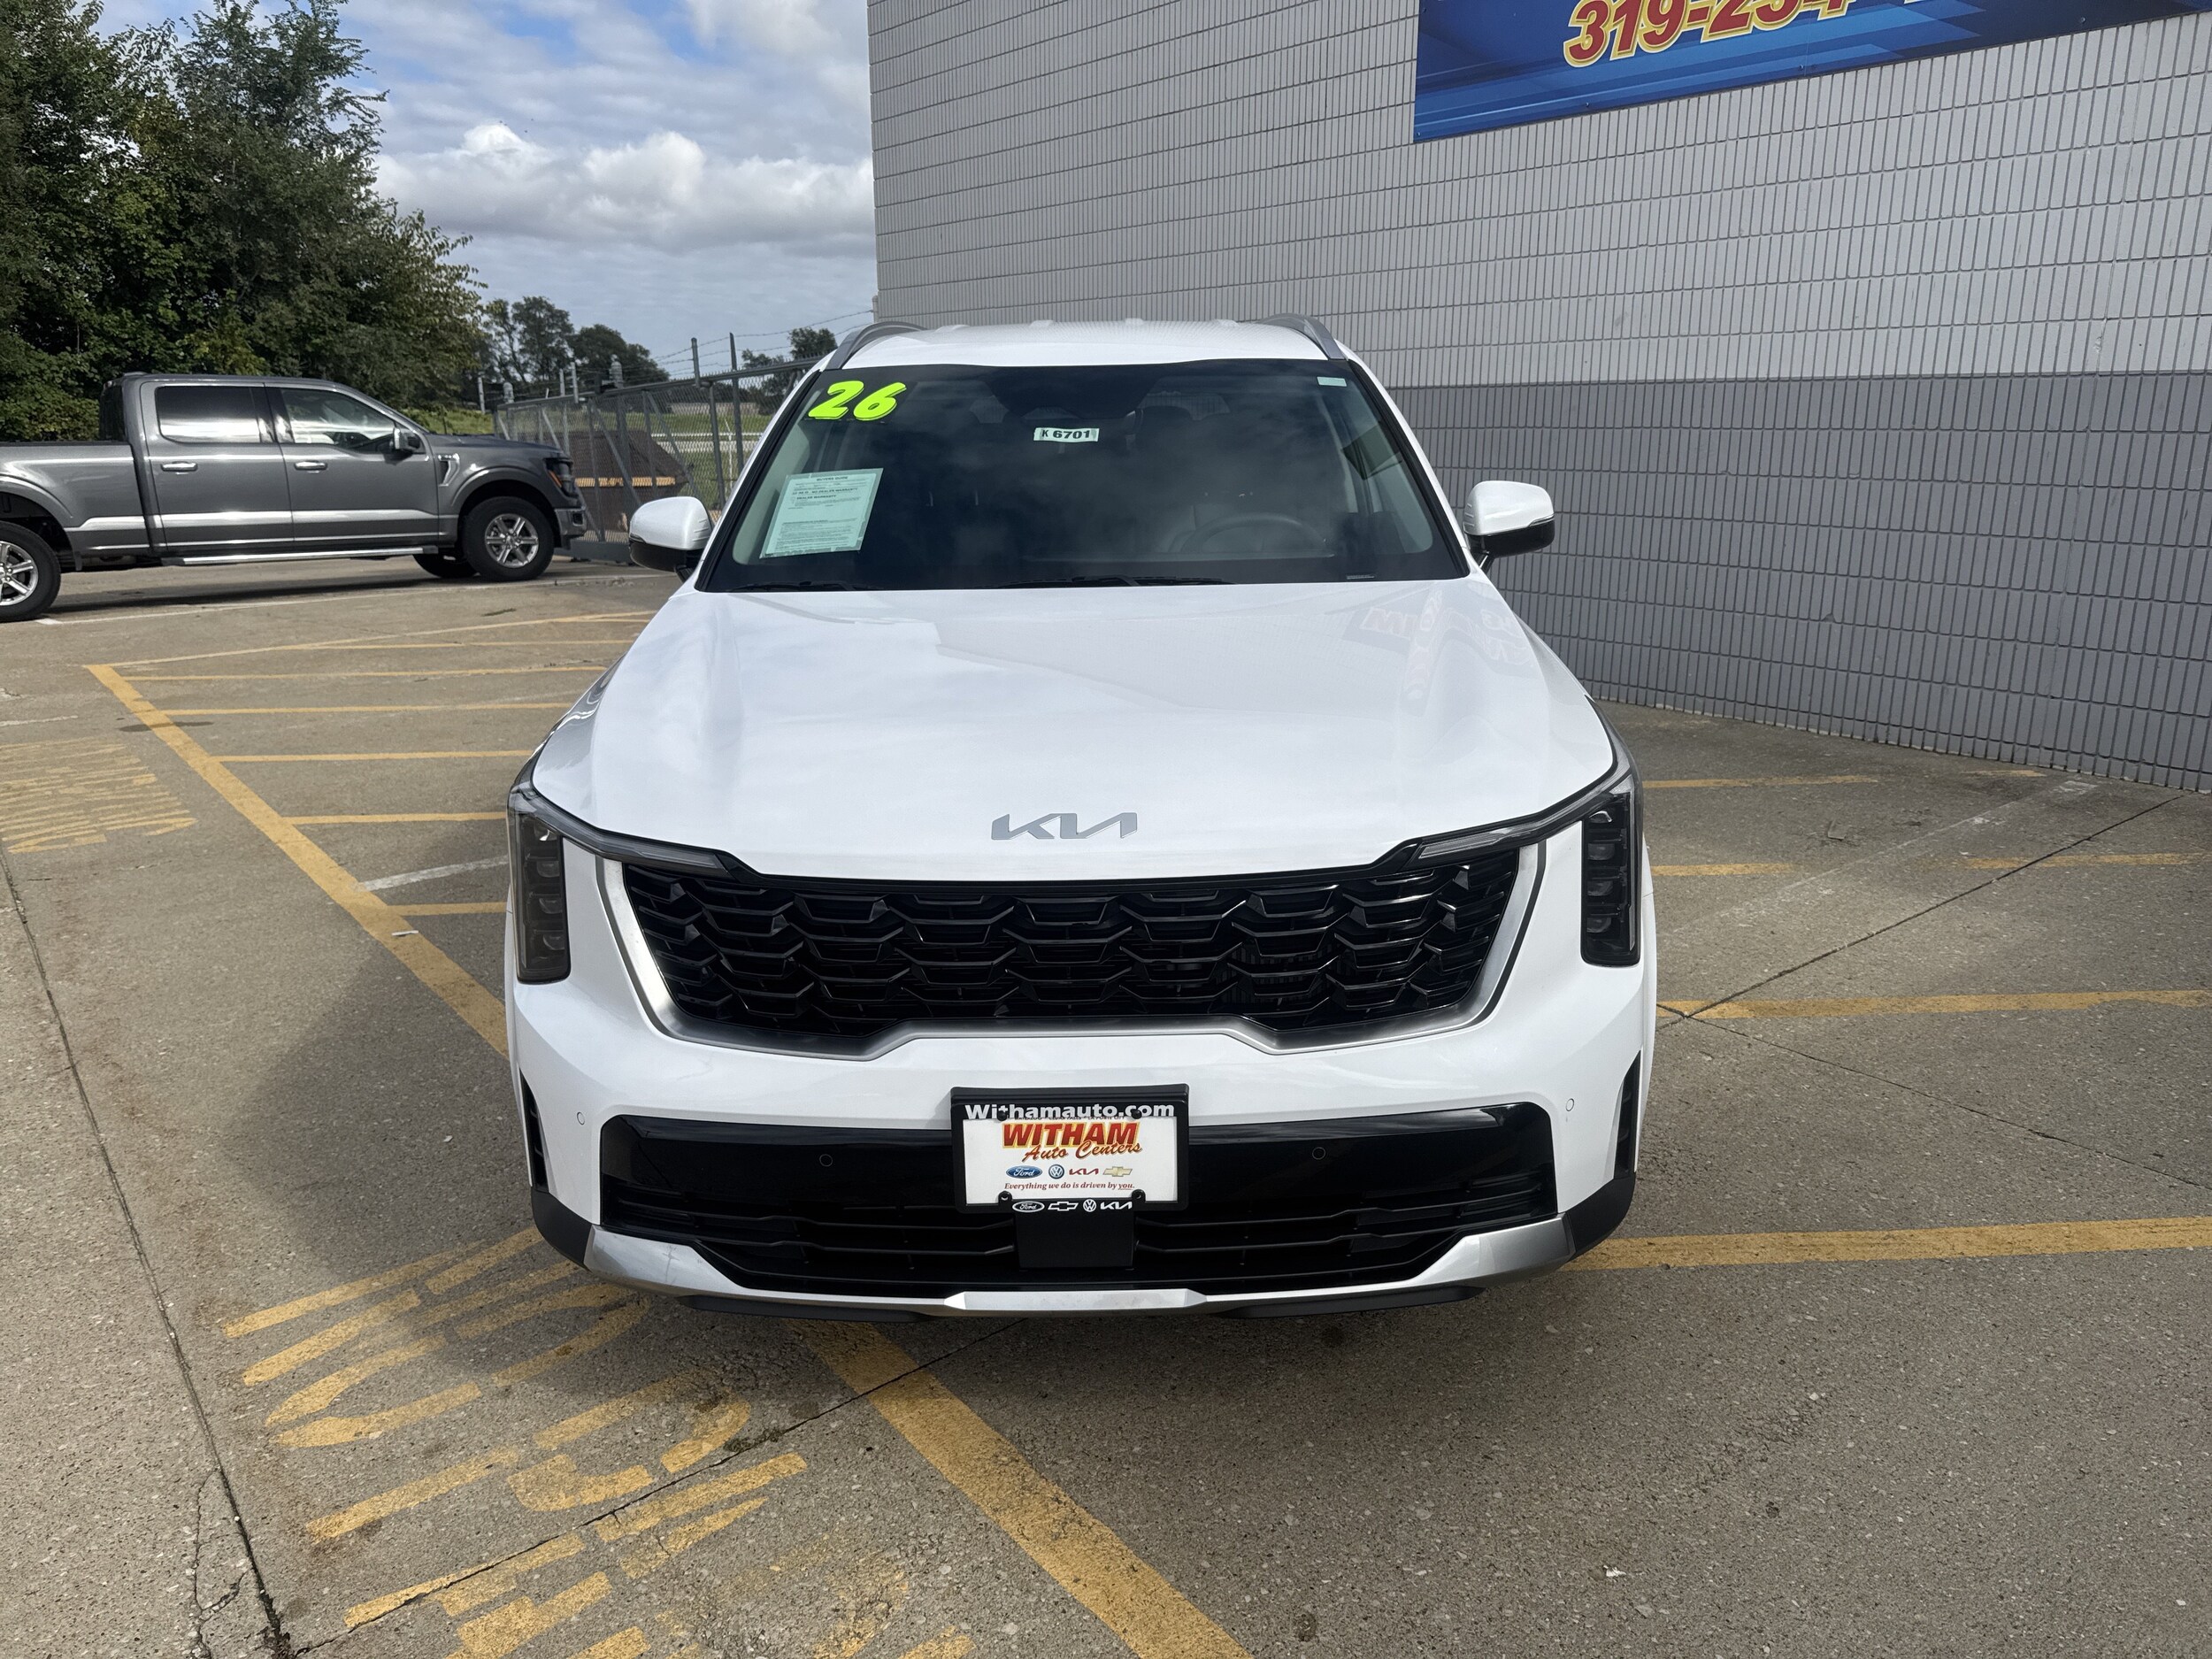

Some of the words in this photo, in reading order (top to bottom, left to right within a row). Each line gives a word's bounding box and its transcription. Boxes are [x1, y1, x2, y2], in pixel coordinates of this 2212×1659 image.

[808, 380, 907, 421] 26
[1053, 430, 1091, 439] 6701
[991, 812, 1138, 840] KIA
[964, 1103, 1175, 1119] Withamauto.com
[1002, 1121, 1141, 1148] WITHAM
[1022, 1144, 1068, 1163] Auto
[1075, 1140, 1142, 1159] Centers
[1004, 1182, 1047, 1191] Everything
[1108, 1181, 1118, 1191] by
[1100, 1201, 1133, 1210] KIA
